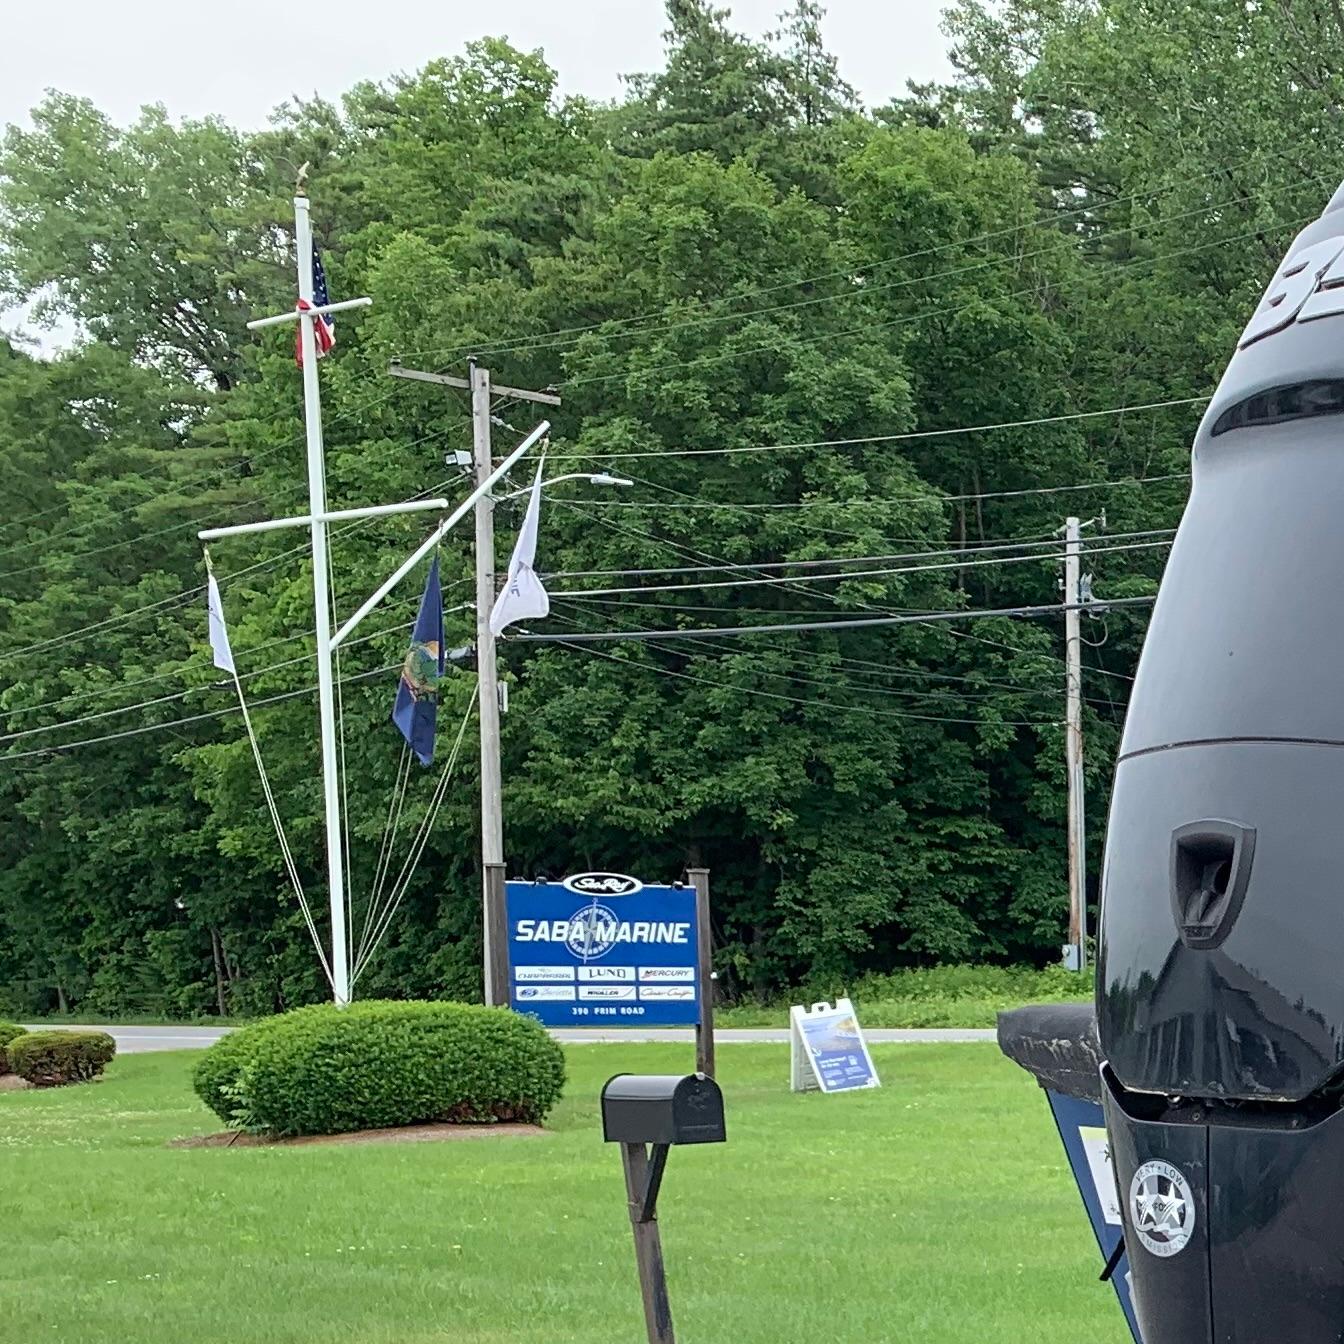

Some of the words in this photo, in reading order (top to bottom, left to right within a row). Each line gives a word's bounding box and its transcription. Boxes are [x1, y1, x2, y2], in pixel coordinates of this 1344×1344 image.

[515, 919, 586, 943] SABA
[594, 921, 691, 944] MARINE
[588, 968, 626, 979] LUND
[643, 969, 690, 978] MERCURY
[572, 1006, 589, 1016] 390
[594, 1006, 617, 1016] PRIM
[621, 1006, 645, 1016] ROAD
[1164, 1166, 1183, 1187] LOW
